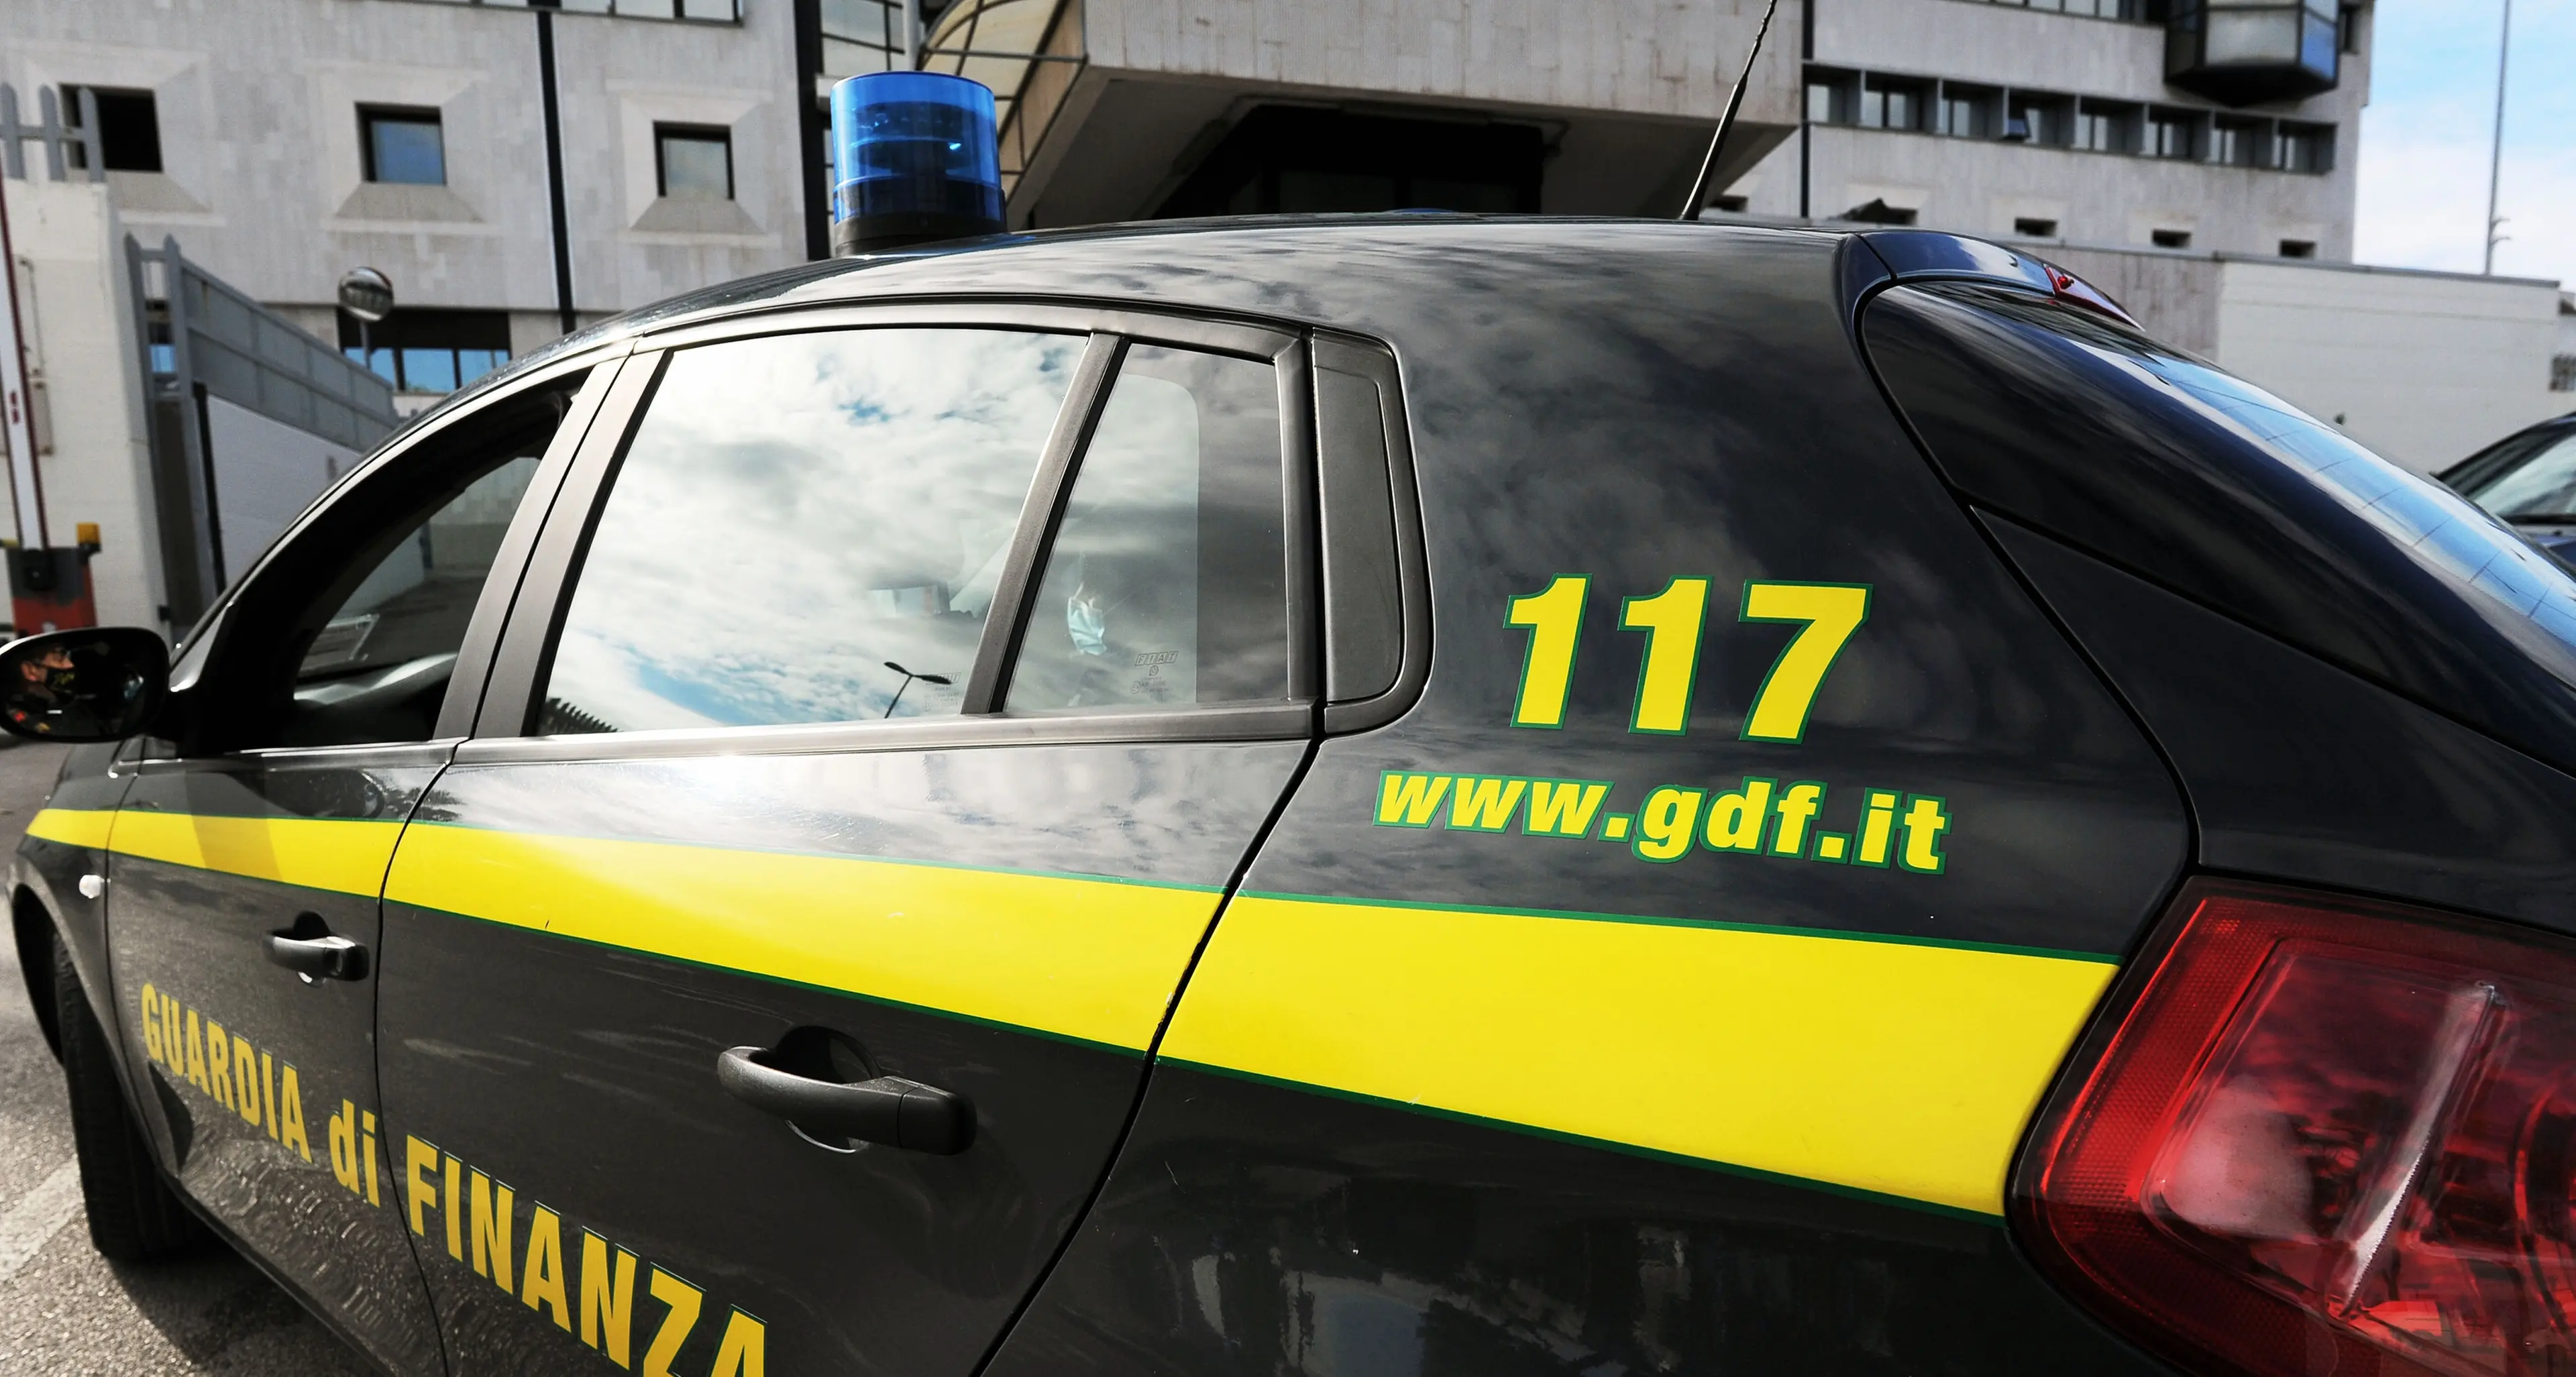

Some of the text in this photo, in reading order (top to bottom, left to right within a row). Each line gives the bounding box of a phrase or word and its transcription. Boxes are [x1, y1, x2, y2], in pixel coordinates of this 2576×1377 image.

[1136, 651, 1179, 665] FIAT
[1505, 574, 1873, 743] 117
[1374, 771, 1951, 873] www.gdf.it
[141, 984, 313, 1162] GUARDIA
[327, 1098, 381, 1209] di
